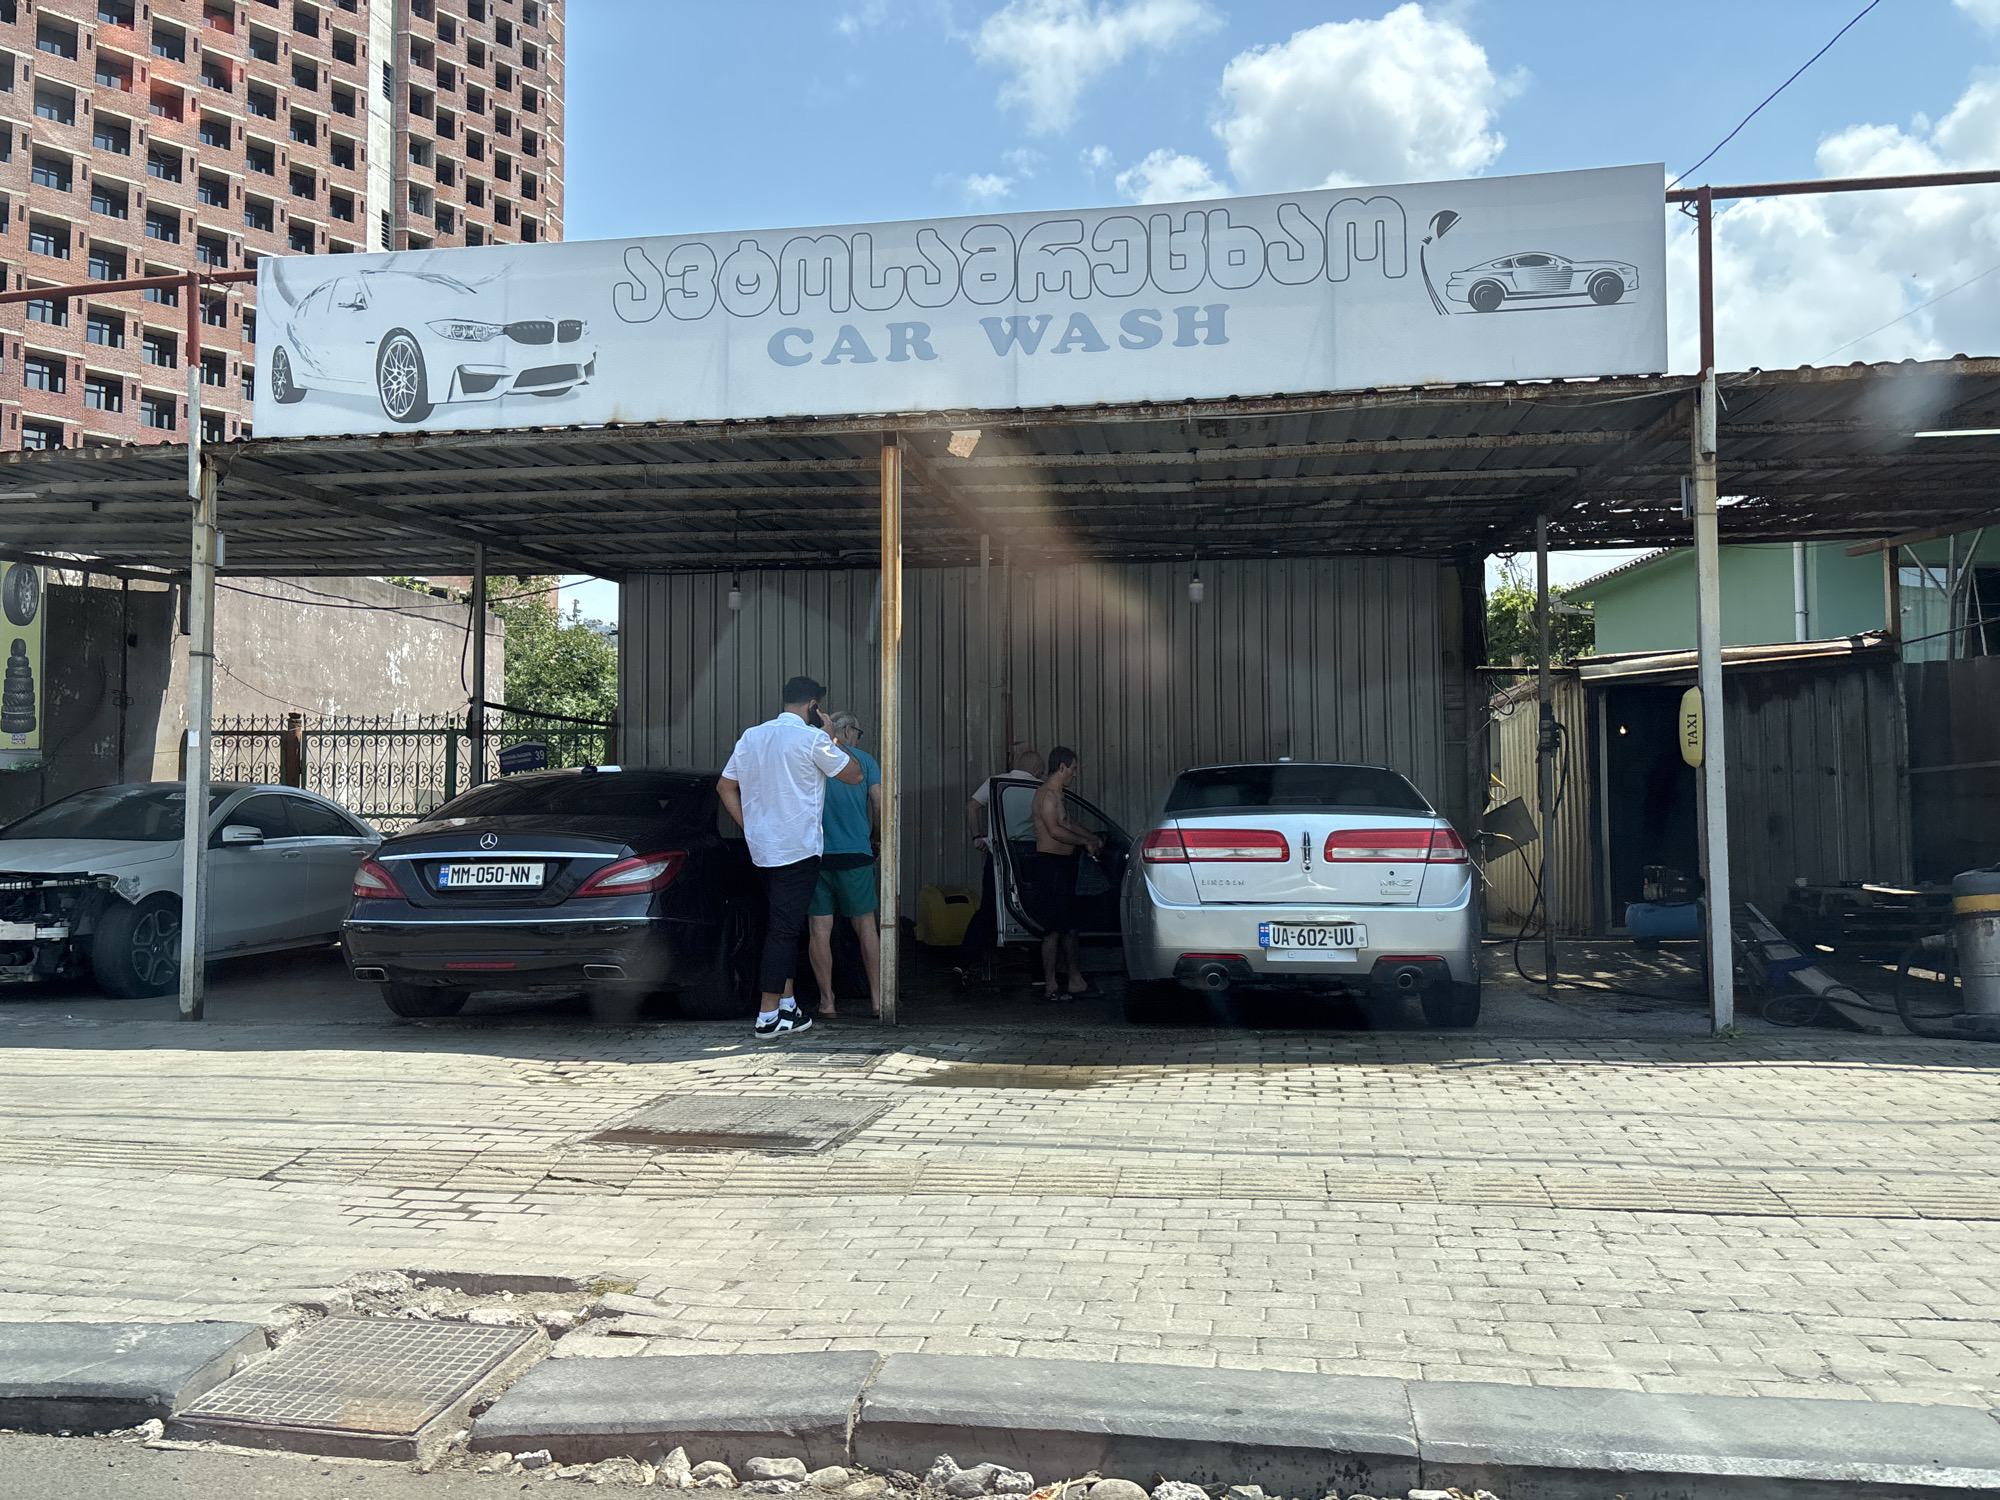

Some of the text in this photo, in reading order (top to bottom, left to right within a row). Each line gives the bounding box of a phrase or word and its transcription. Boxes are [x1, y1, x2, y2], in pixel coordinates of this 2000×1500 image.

[613, 196, 1407, 323] ავტოსამრეცხაო
[767, 303, 1231, 367] CAR WASH
[1687, 713, 1698, 747] TAXI
[534, 749, 545, 761] 39
[450, 866, 530, 884] MM-050-NN
[1260, 927, 1354, 946] GE UA-602-UU
